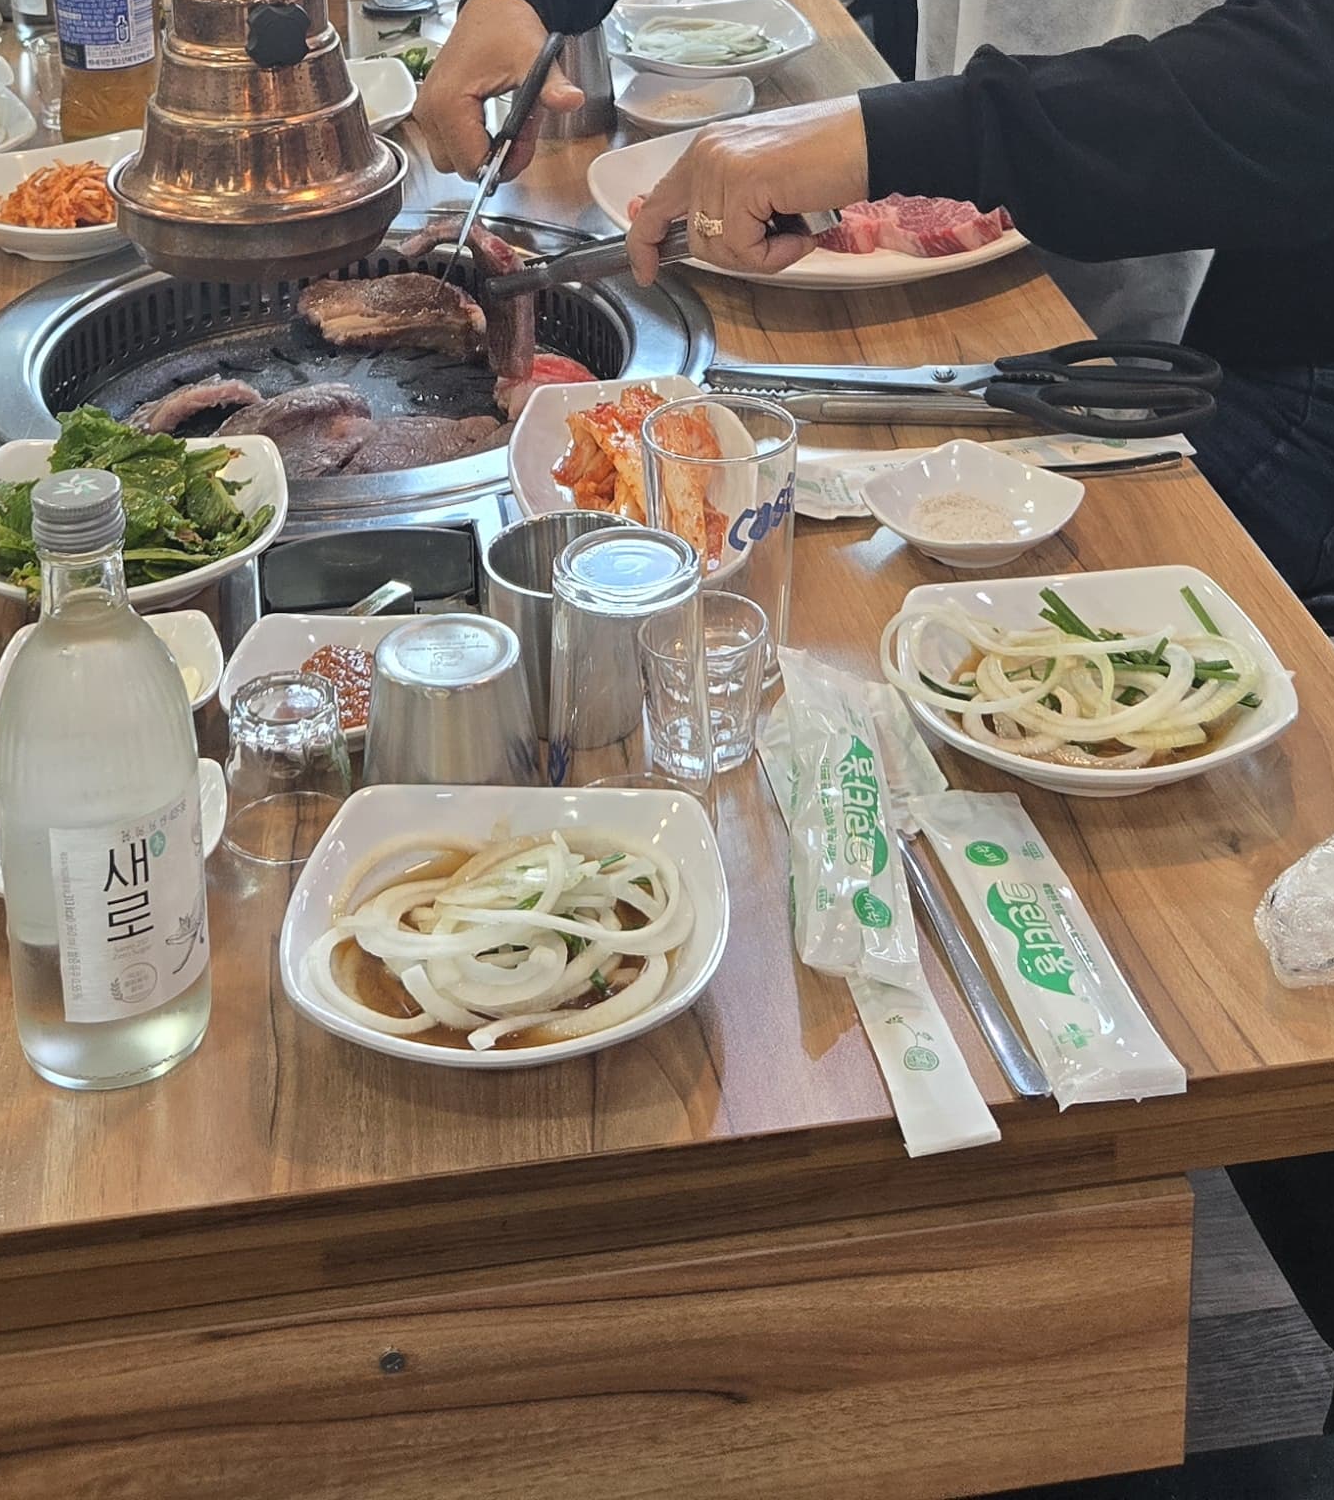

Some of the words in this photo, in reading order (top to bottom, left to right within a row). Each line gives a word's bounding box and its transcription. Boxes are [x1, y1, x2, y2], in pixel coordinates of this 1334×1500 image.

[835, 754, 877, 867] 크린타올
[103, 839, 155, 942] 새로
[996, 880, 1077, 977] 크린타올
